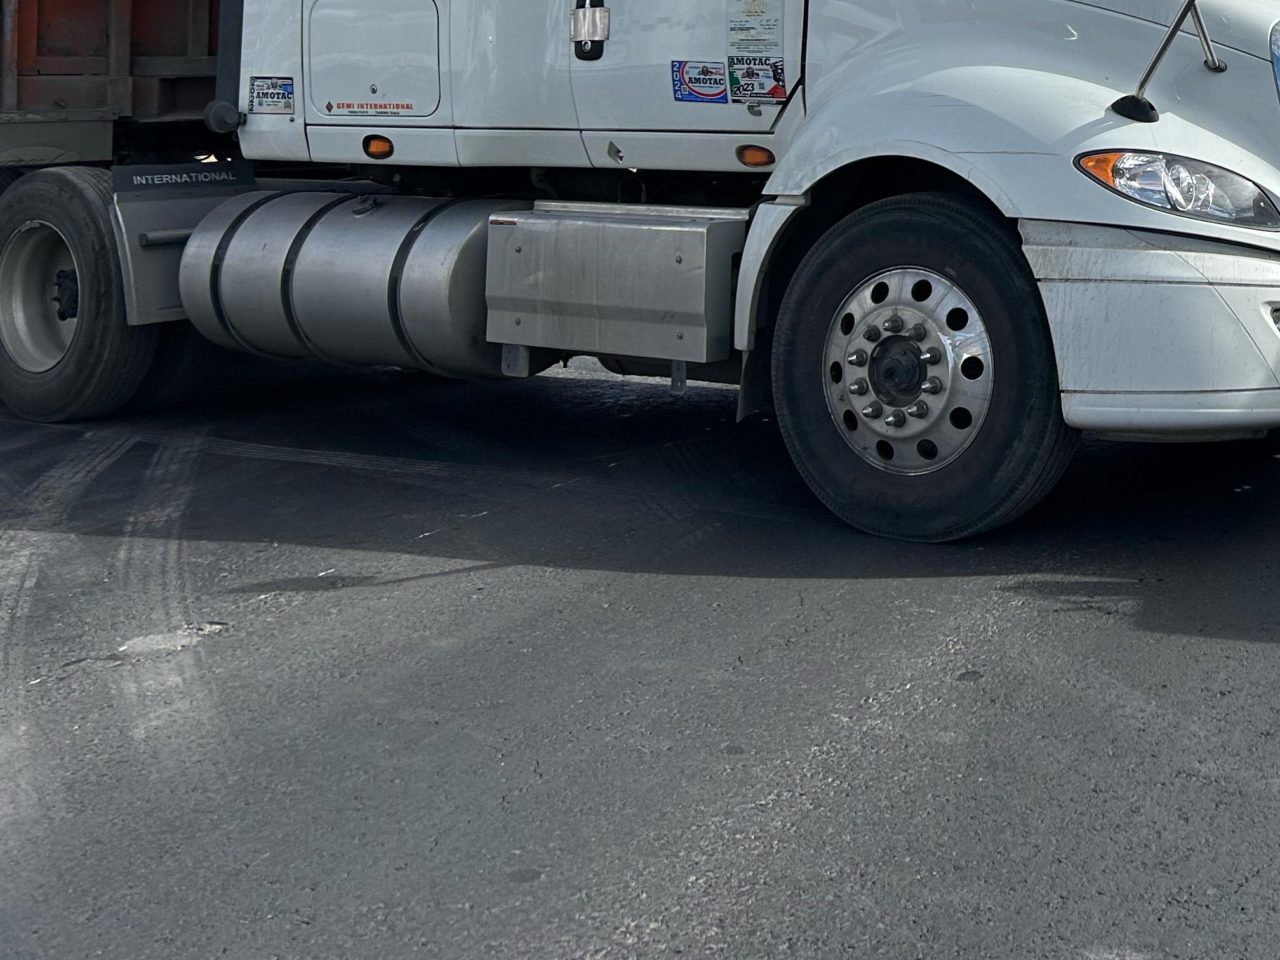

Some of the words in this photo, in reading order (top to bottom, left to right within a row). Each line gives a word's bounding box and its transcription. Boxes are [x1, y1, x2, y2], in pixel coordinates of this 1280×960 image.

[729, 57, 771, 66] AMOTAC
[673, 62, 682, 99] 2024
[688, 76, 725, 86] AMOTAC
[255, 92, 293, 100] AMOTAC
[357, 103, 413, 111] INTERNATIONAL
[133, 171, 237, 185] INTERNATIONAL
